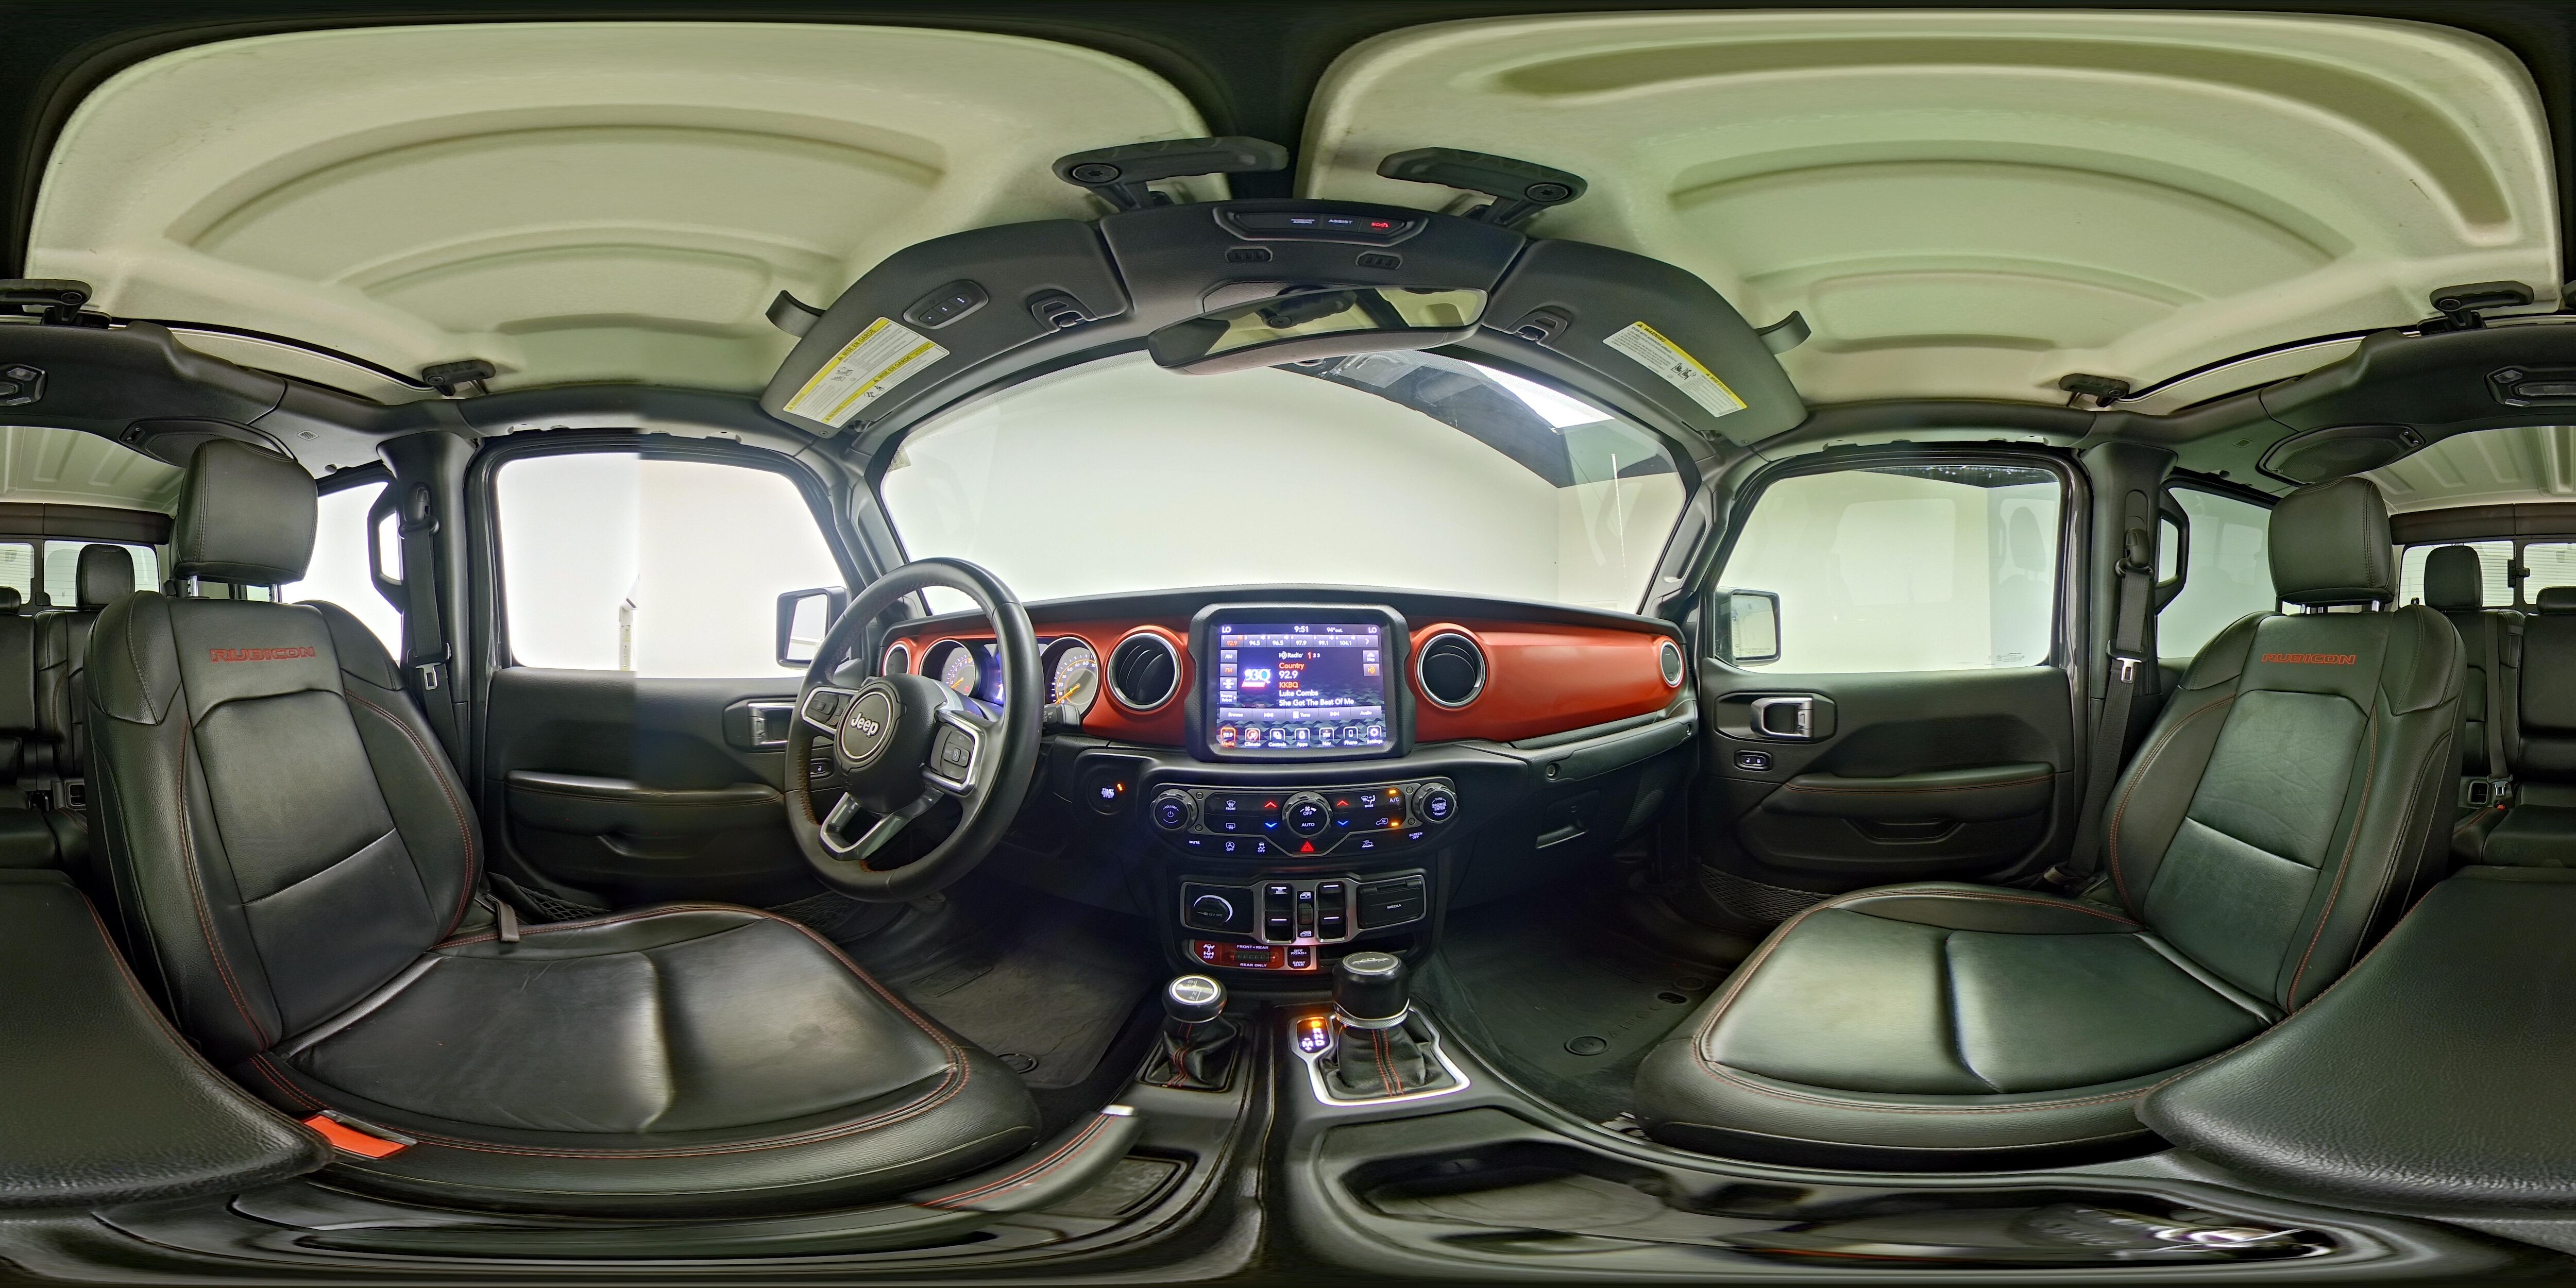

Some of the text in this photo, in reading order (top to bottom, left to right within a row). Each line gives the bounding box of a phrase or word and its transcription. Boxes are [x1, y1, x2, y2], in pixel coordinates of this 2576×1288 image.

[842, 346, 853, 356] MISE
[858, 329, 876, 344] GARDE
[1644, 328, 1666, 342] WARNING
[878, 369, 889, 379] MISE
[894, 355, 912, 367] GARDE
[209, 646, 316, 663] RUBICON
[2261, 653, 2357, 665] RUBICON
[1244, 669, 1272, 684] 93Q
[1279, 670, 1298, 679] 92.9
[851, 712, 880, 738] Jeep
